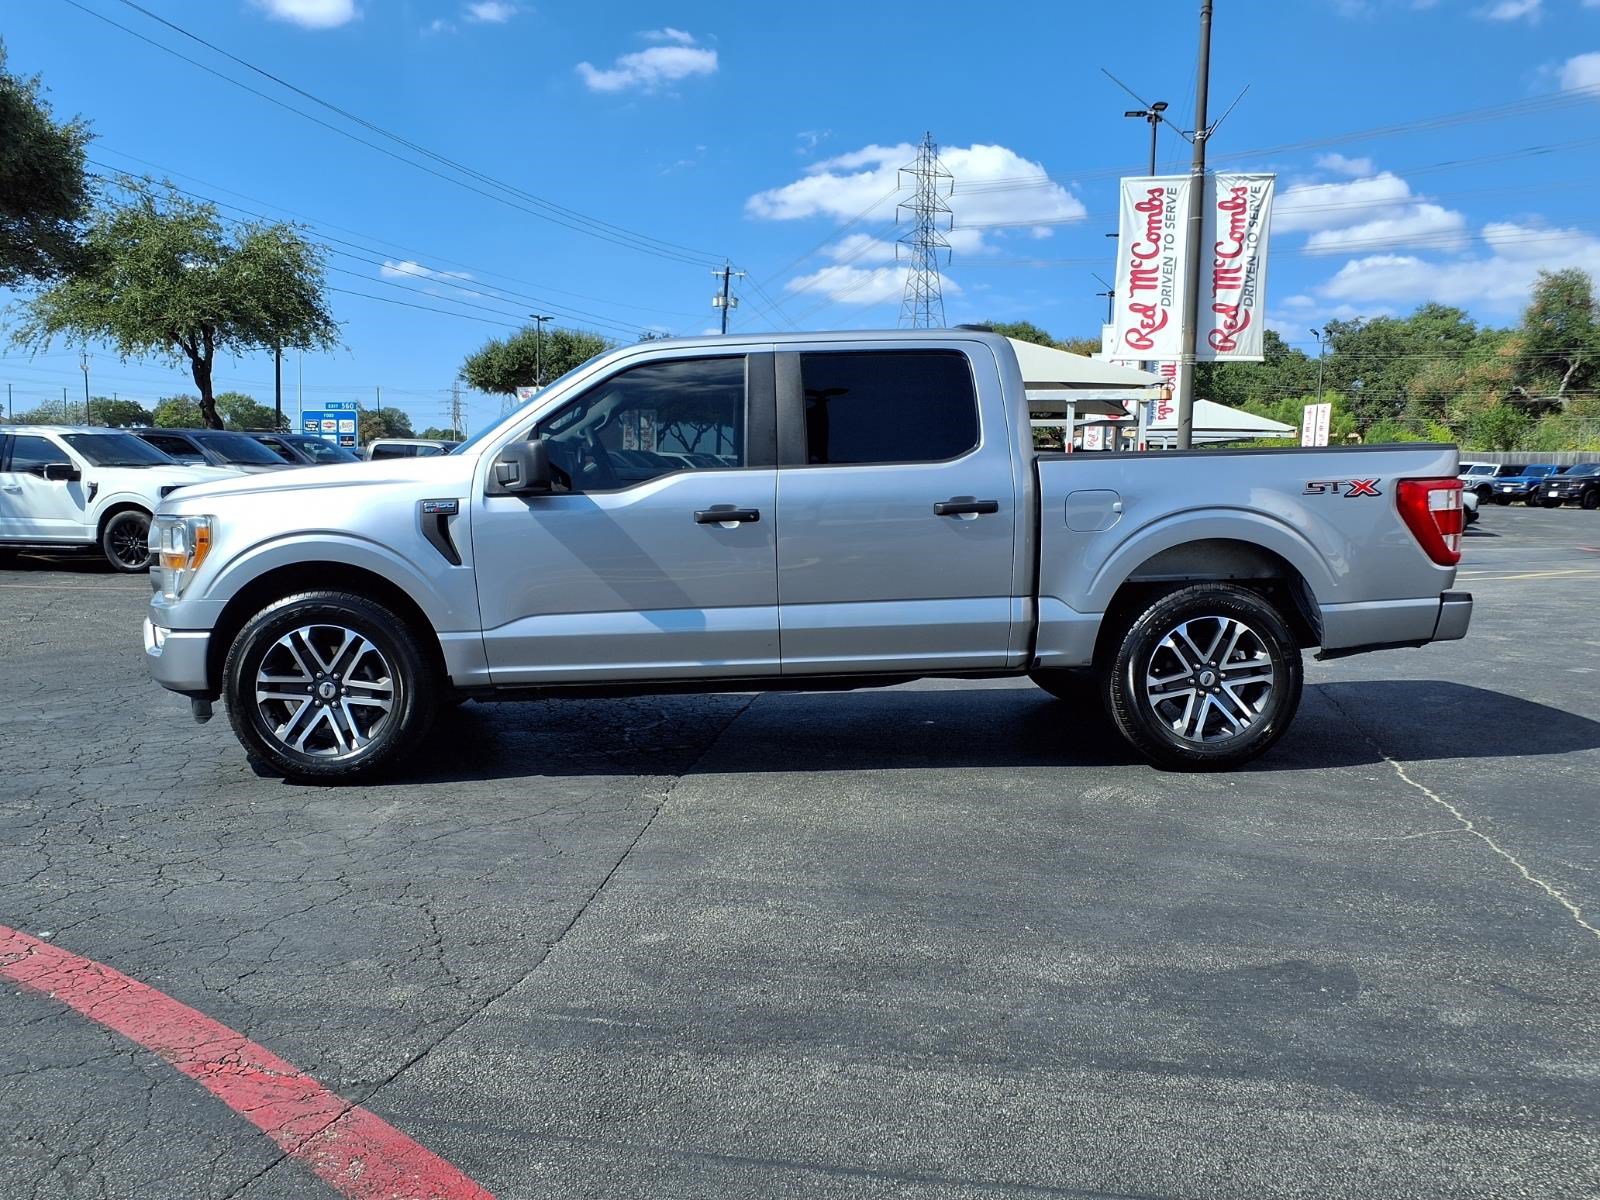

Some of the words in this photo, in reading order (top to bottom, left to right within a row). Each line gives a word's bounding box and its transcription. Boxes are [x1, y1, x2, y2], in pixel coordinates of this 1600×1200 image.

[1165, 187, 1177, 231] SERVE
[1249, 186, 1261, 228] SERVE
[1129, 187, 1164, 298] McCombs
[1163, 234, 1175, 253] TO
[1212, 187, 1248, 298] McCombs
[1247, 233, 1259, 251] TO
[1161, 257, 1174, 307] DRIVEN
[1244, 256, 1257, 307] DRIVEN
[1125, 303, 1168, 350] Red
[1208, 303, 1250, 351] Red
[1302, 478, 1382, 498] STX
